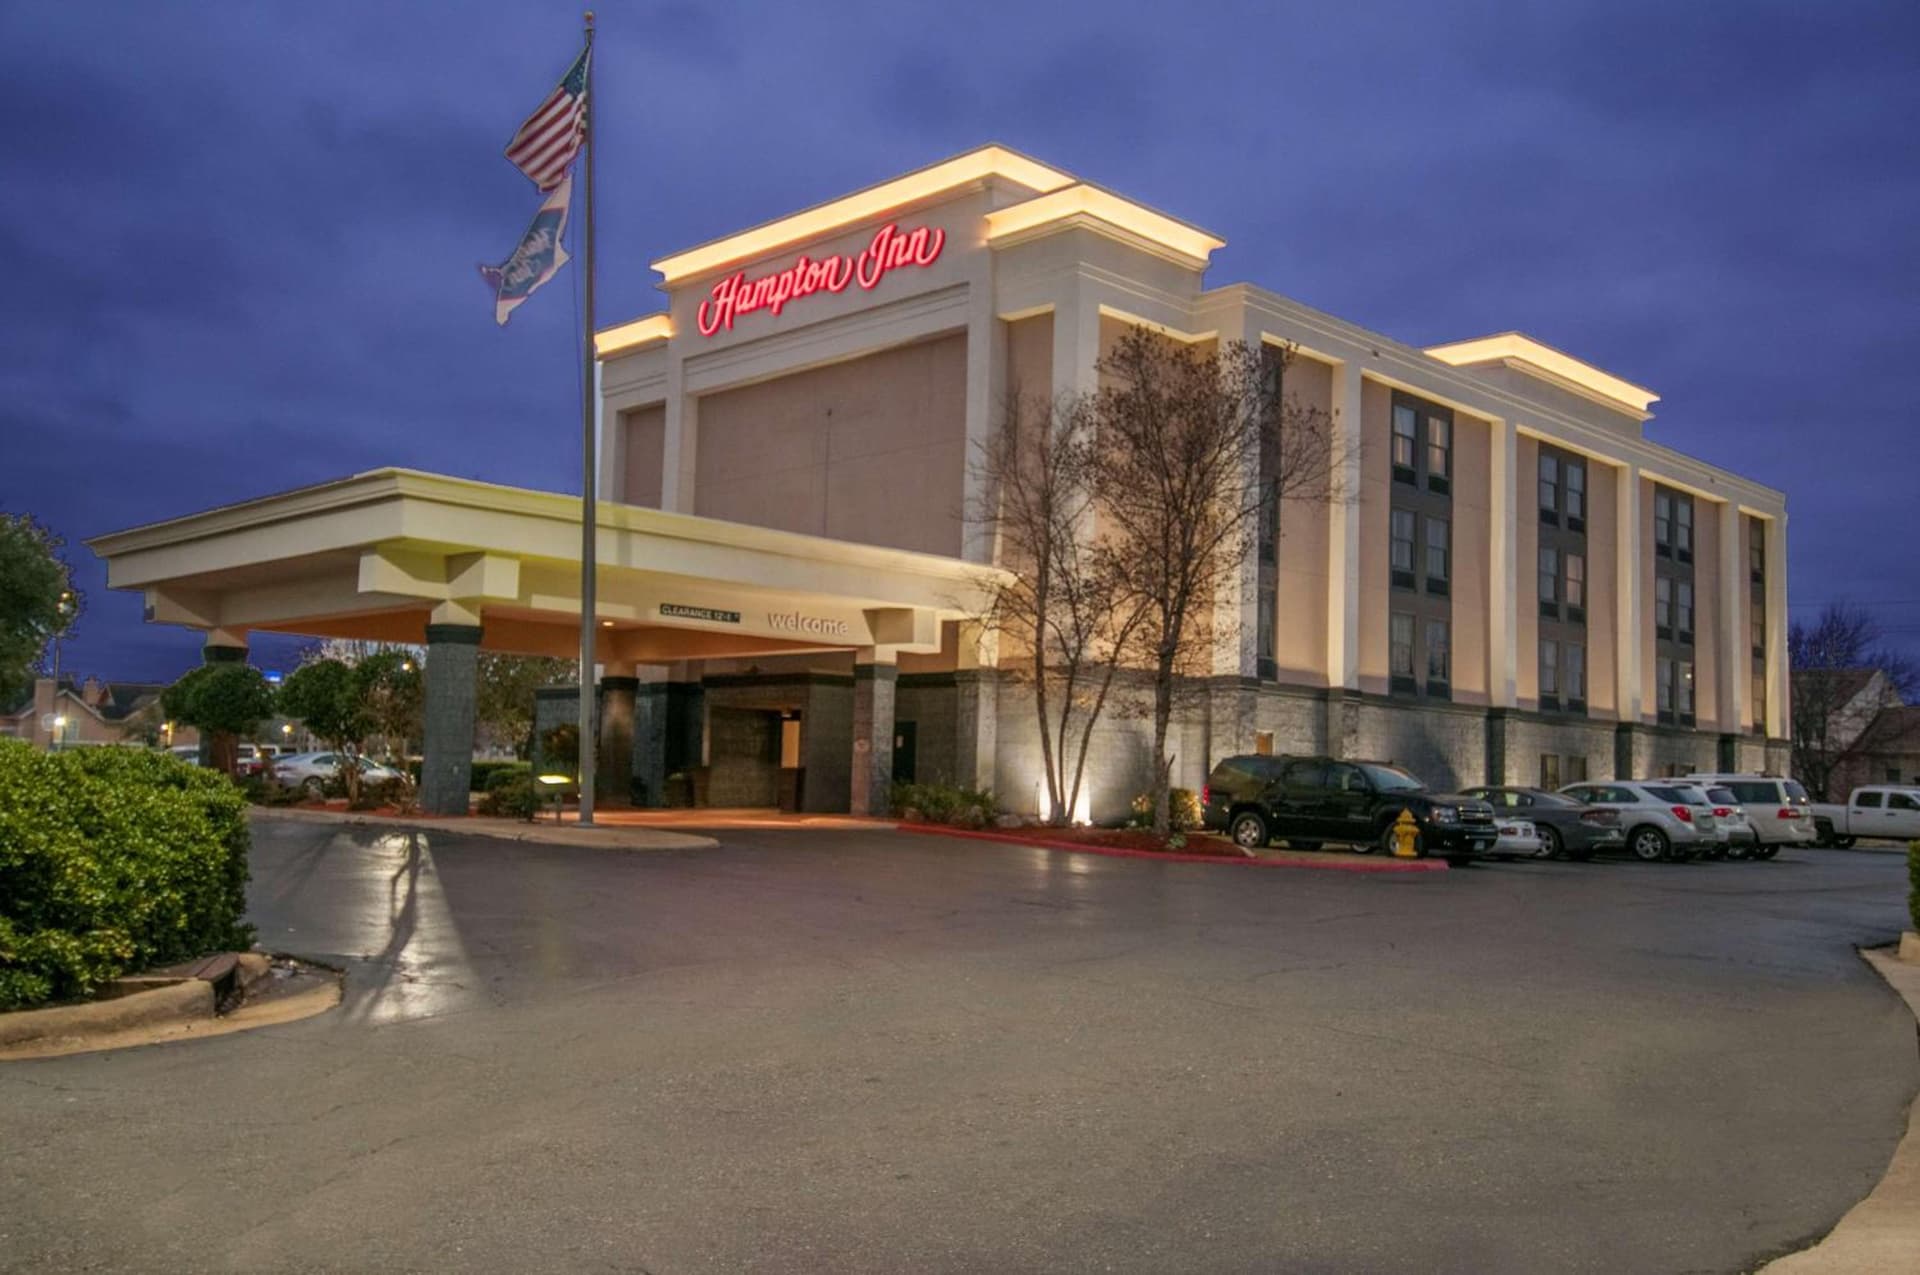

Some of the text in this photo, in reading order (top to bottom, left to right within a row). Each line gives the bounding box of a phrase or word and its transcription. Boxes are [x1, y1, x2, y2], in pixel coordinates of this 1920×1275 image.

[697, 223, 946, 337] Hampton Inn
[662, 604, 712, 619] CLEARANCE
[767, 611, 849, 636] welcome
